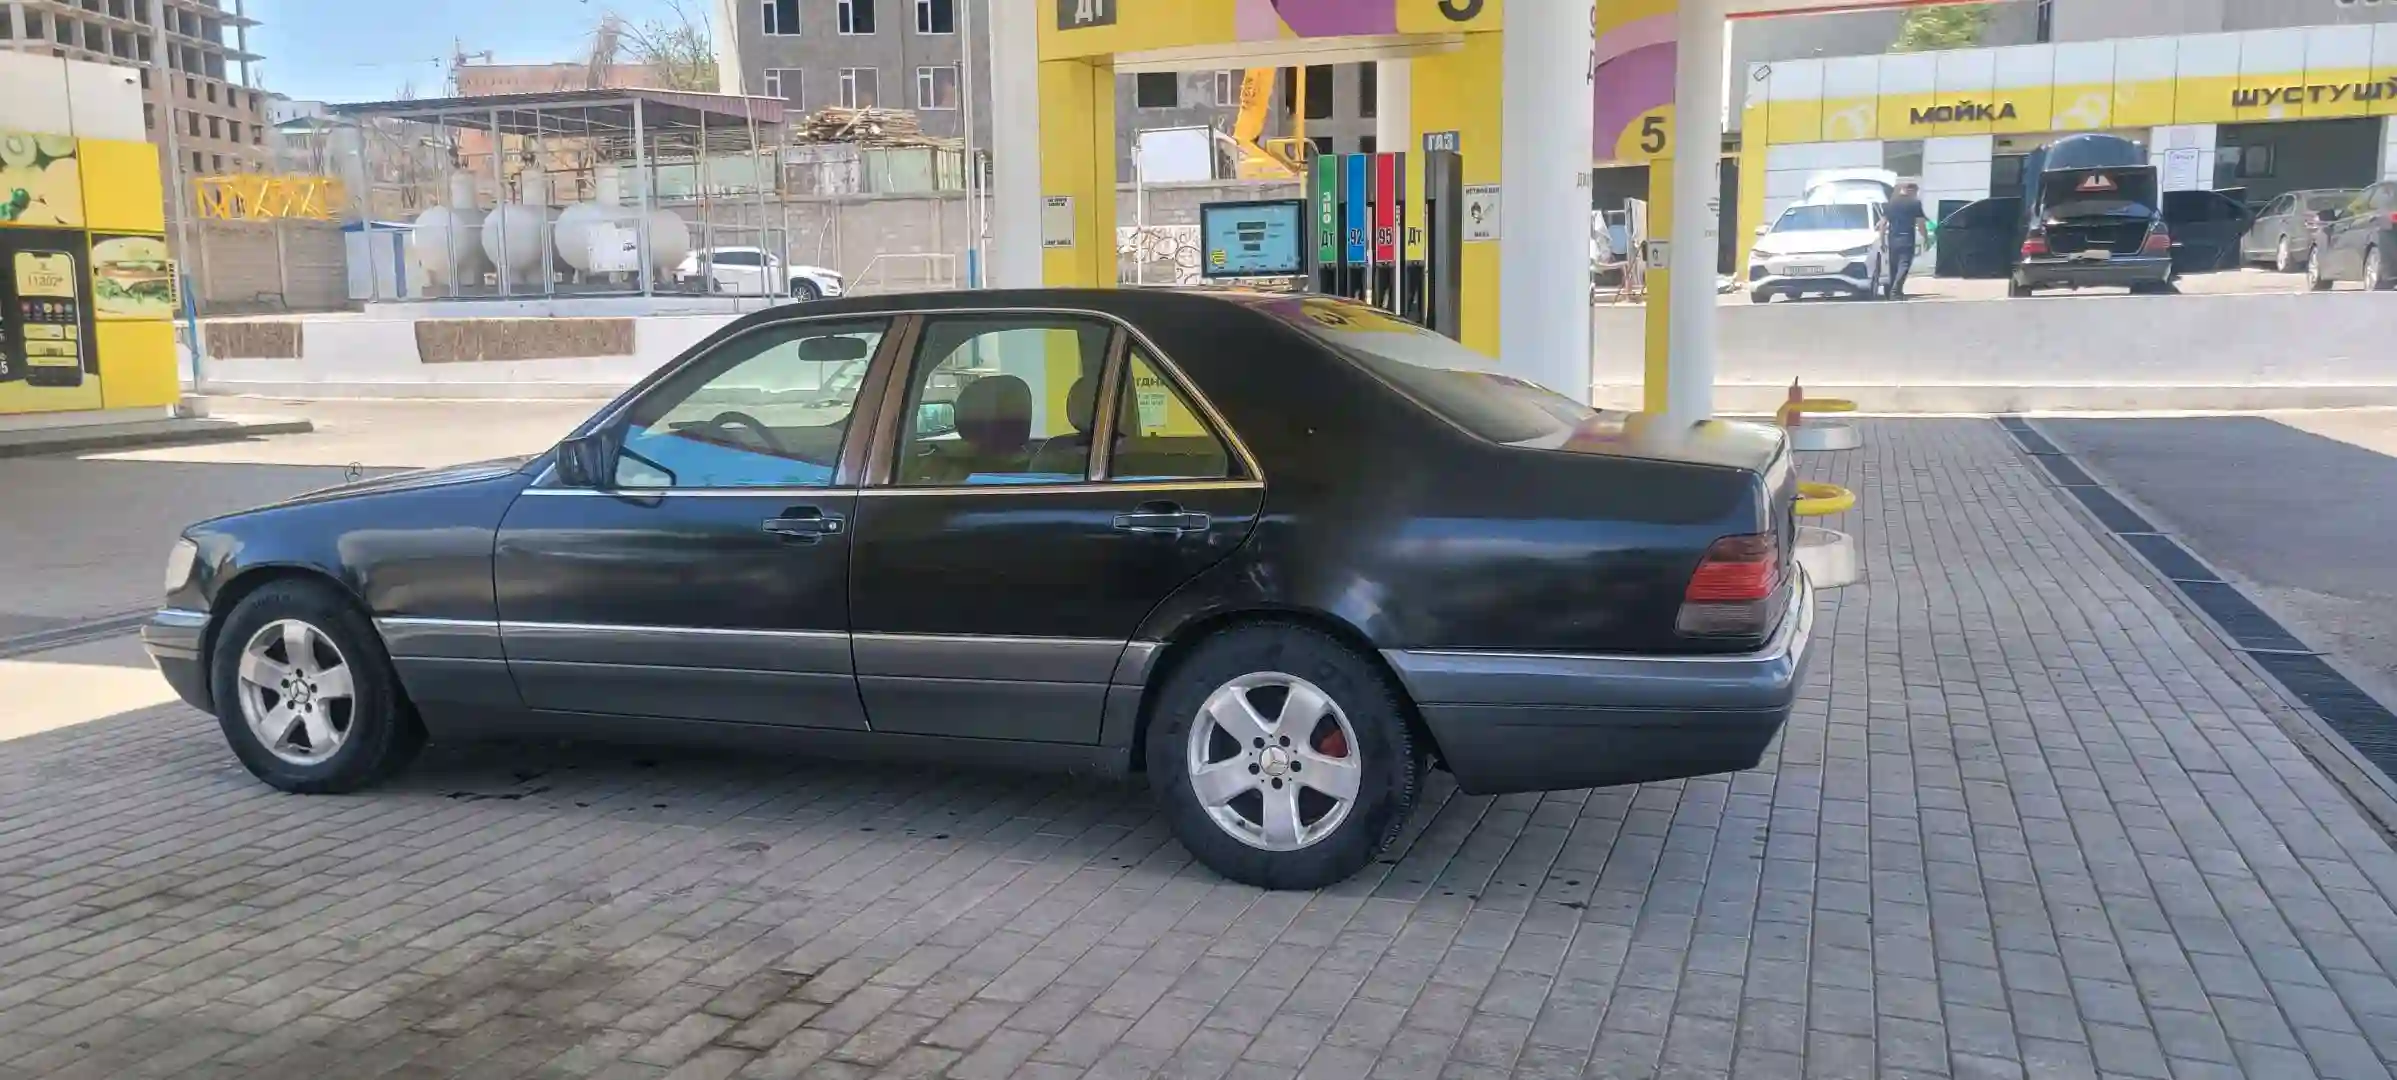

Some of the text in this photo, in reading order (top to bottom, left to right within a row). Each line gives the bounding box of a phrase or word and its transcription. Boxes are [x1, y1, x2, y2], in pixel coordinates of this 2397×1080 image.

[1909, 99, 2017, 125] МОЙКА
[1428, 133, 1453, 151] ГАЗ
[1640, 116, 1666, 154] 5
[1378, 228, 1393, 245] 95
